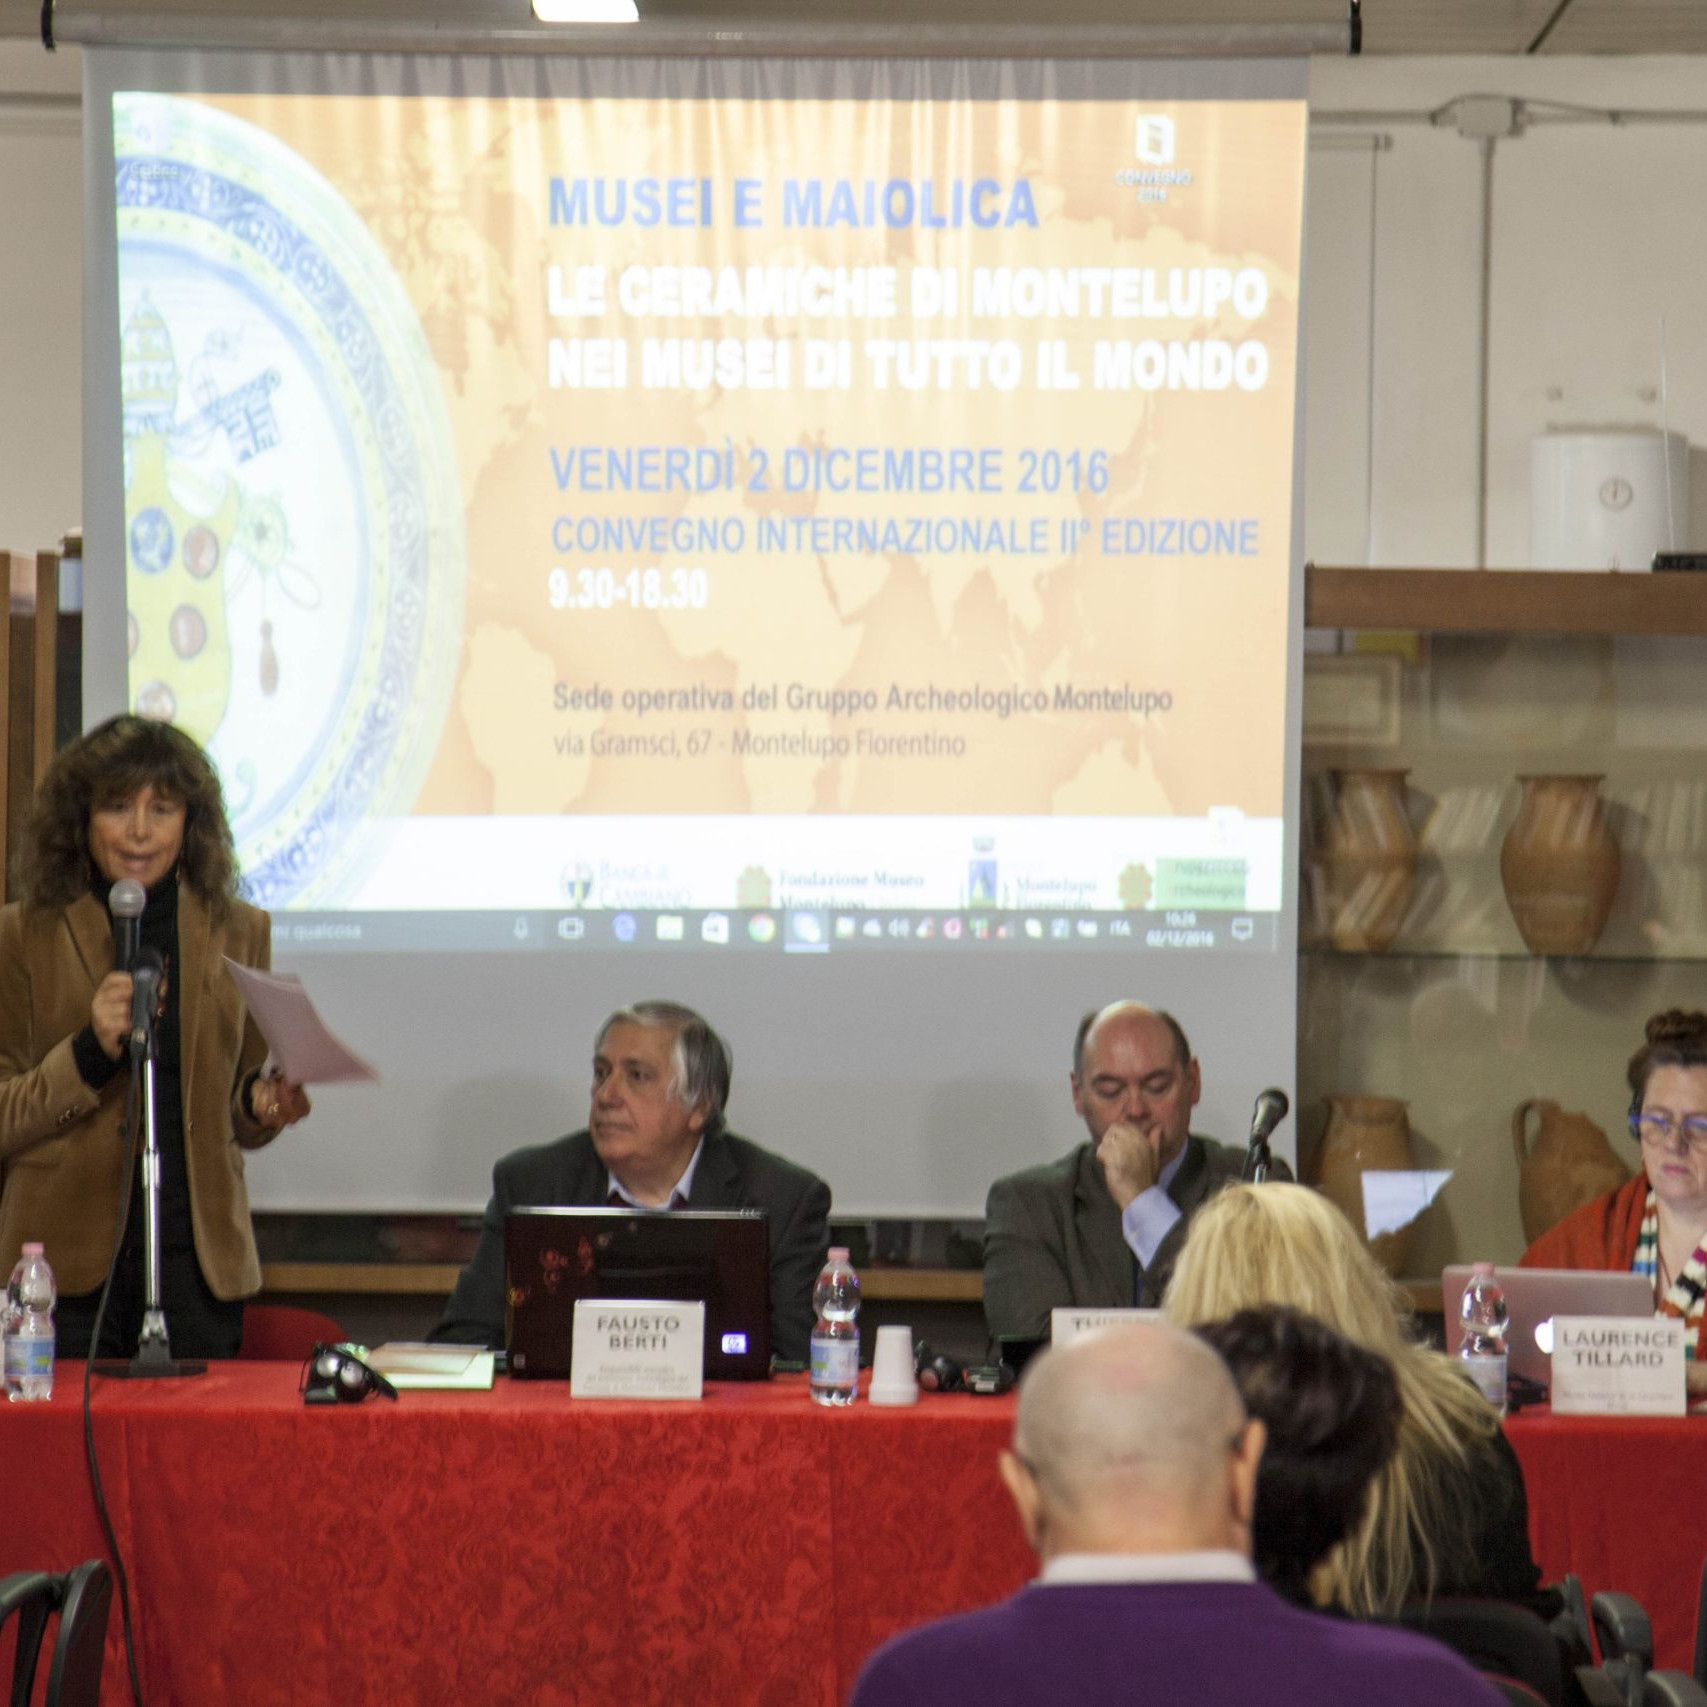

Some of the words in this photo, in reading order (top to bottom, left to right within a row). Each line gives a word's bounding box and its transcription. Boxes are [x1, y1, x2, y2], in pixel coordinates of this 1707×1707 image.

[1115, 170, 1193, 187] CONVEGNO
[549, 178, 712, 228] MUSEI
[734, 179, 763, 228] E
[783, 179, 1039, 228] MAIOLICA
[547, 265, 604, 317] LE
[619, 265, 897, 318] CERAMICHE
[911, 267, 960, 318] DI
[973, 267, 1269, 319] MONTELUPO
[548, 338, 626, 389] NEI
[641, 338, 792, 390] MUSEI
[806, 339, 852, 390] DI
[865, 339, 1023, 390] TUTTO
[1036, 340, 1080, 390] IL
[1093, 340, 1269, 391] MONDO
[549, 439, 736, 493] VENERDÌ
[748, 447, 769, 493] 2
[783, 447, 1004, 494] DICEMBRE
[1017, 448, 1109, 495] 2016
[552, 515, 745, 554] CONVEGNO
[756, 516, 1048, 556] INTERNAZIONALE
[1101, 518, 1260, 557] EDIZIONE
[548, 566, 708, 610] 9.30-18.30
[553, 682, 613, 712] Sede
[621, 683, 733, 718] operativa
[742, 683, 778, 712] del
[786, 684, 878, 718] Gruppo
[885, 684, 1047, 720] Archeologico
[1053, 683, 1173, 719] Montelupo
[554, 728, 584, 756] via
[687, 729, 712, 756] 67
[732, 728, 850, 762] Montelupo
[855, 729, 966, 757] Fiorentino
[780, 868, 868, 887] Fondazione
[874, 868, 924, 887] Museo
[597, 1313, 680, 1334] FAUSTO
[1563, 1329, 1679, 1349] LAURENCE
[609, 1334, 667, 1351] BERTI
[1573, 1350, 1664, 1369] TILLARD
